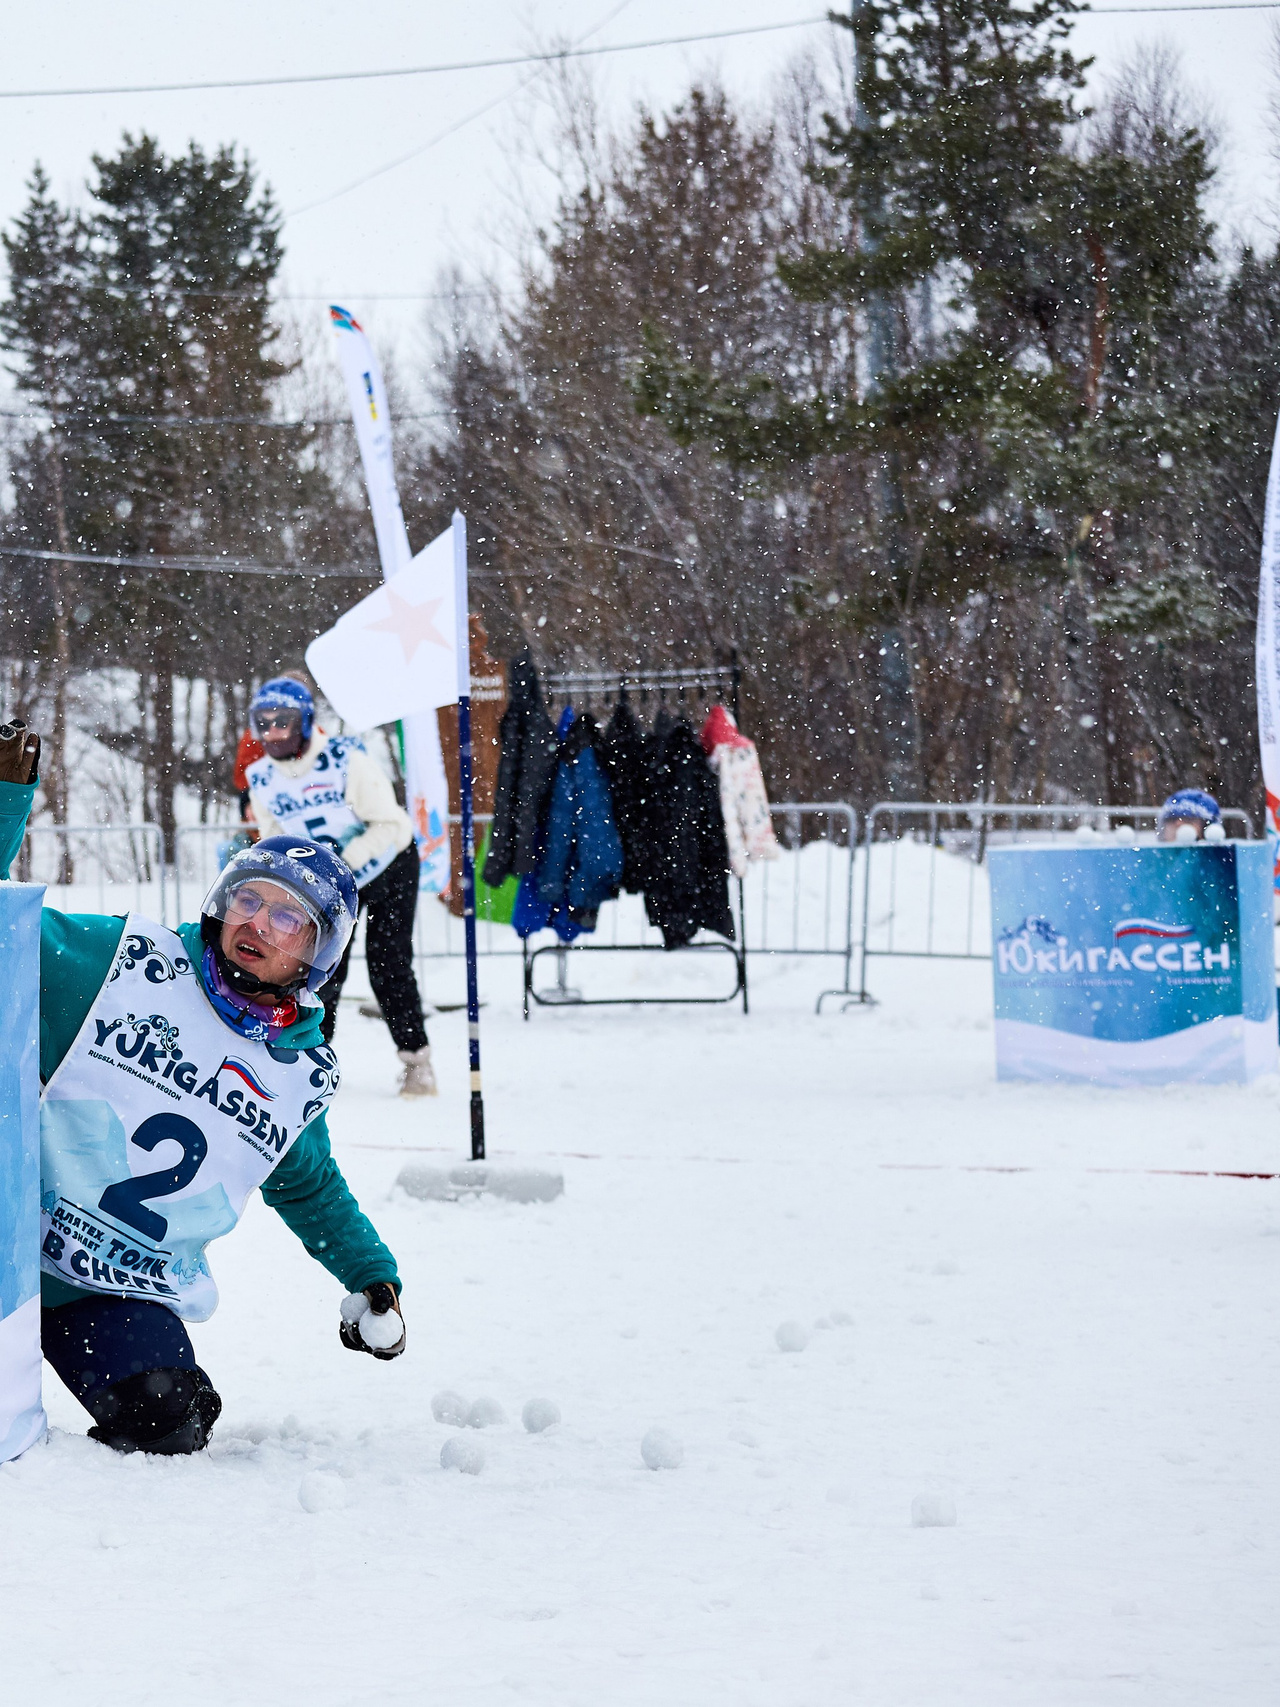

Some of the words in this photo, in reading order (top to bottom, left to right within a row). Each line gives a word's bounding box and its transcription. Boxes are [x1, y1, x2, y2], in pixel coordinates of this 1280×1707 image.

[304, 816, 344, 857] 5
[88, 1049, 116, 1067] RUSSIA,
[116, 1061, 157, 1087] MURMANSK
[155, 1082, 183, 1102] REGION
[237, 1131, 266, 1156] СНЕЖНЫЙ
[261, 1149, 276, 1164] БОЙ
[98, 1112, 209, 1243] 2
[51, 1218, 72, 1236] КТО
[72, 1231, 101, 1252] ЗНАЕТ
[53, 1207, 81, 1229] ДЛЯ
[80, 1220, 106, 1243] ТЕХ,
[42, 1229, 65, 1261] В
[106, 1238, 167, 1280] ТОЛК
